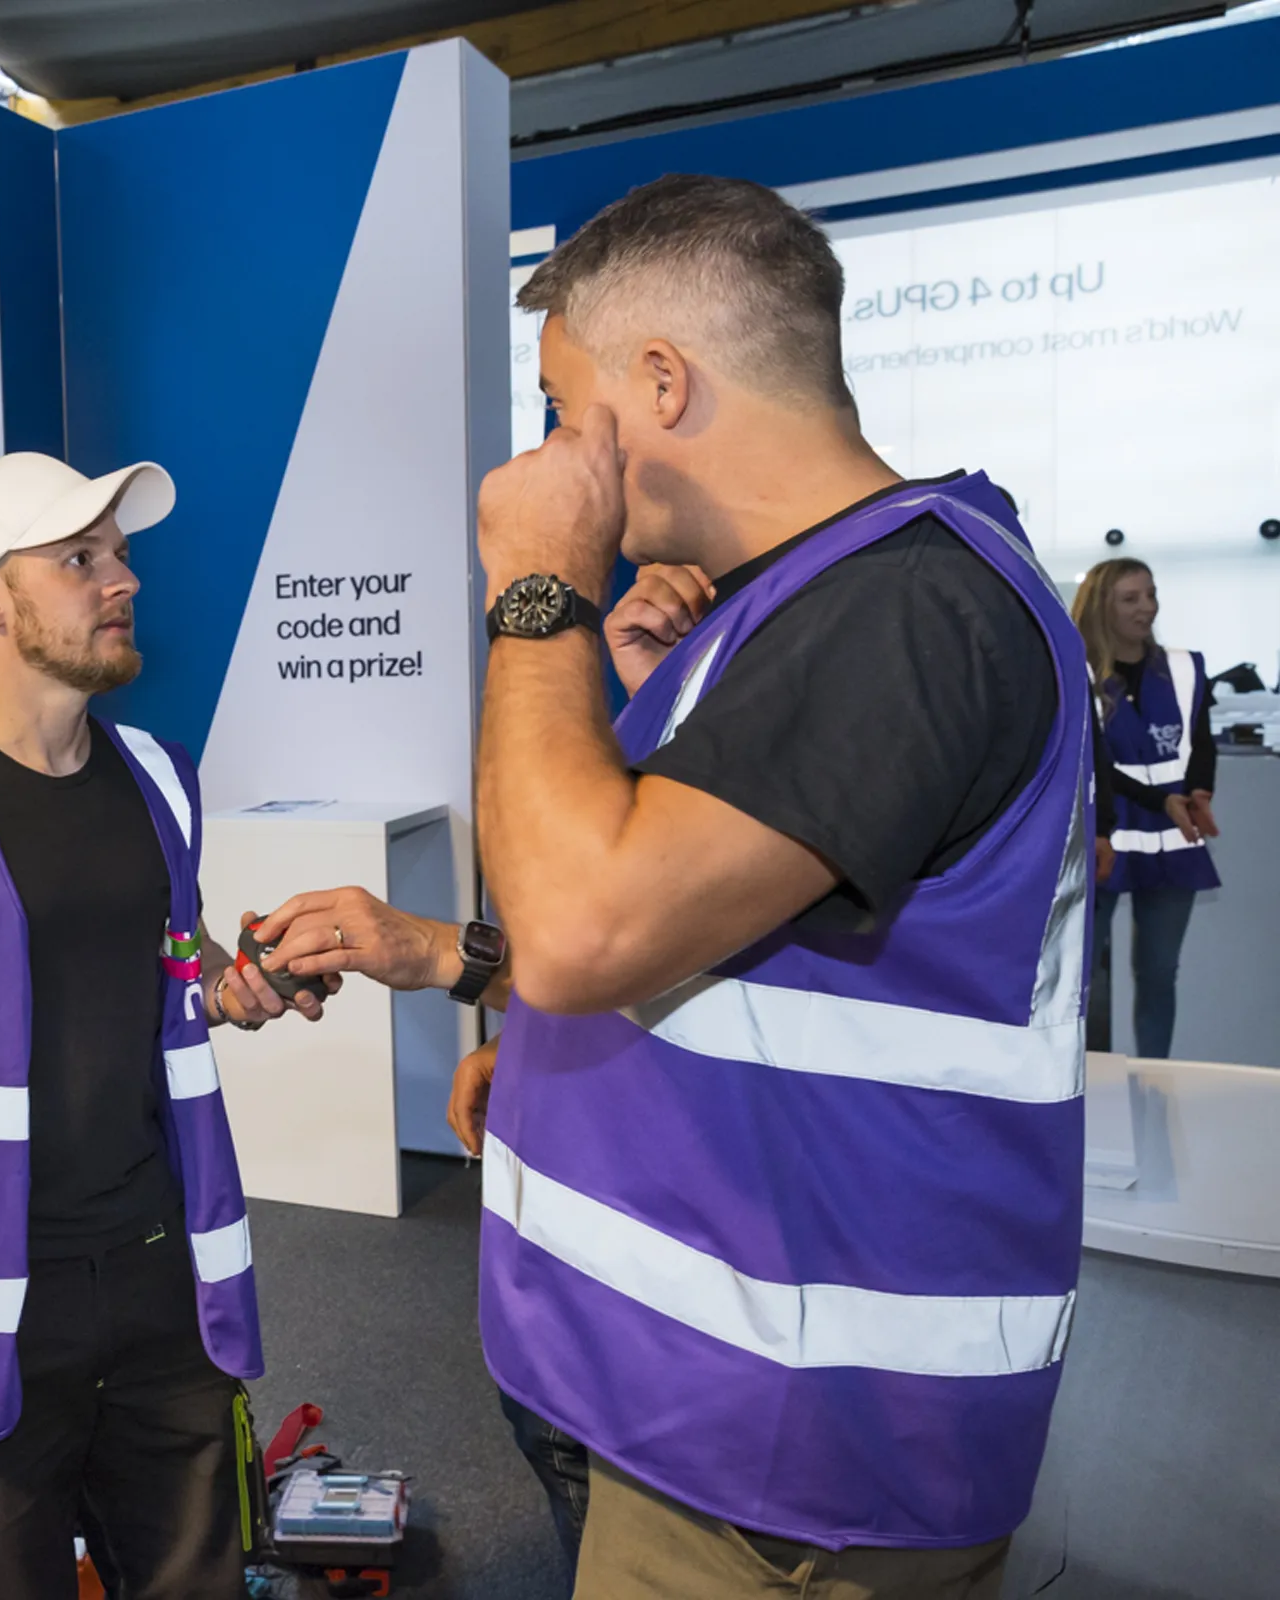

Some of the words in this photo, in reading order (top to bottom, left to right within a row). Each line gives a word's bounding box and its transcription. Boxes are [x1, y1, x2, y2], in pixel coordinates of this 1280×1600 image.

[275, 574, 346, 600] Enter
[349, 572, 412, 602] your
[276, 612, 344, 640] code
[348, 609, 401, 637] and
[277, 654, 323, 680] win
[326, 658, 344, 679] a
[349, 650, 423, 684] prize!
